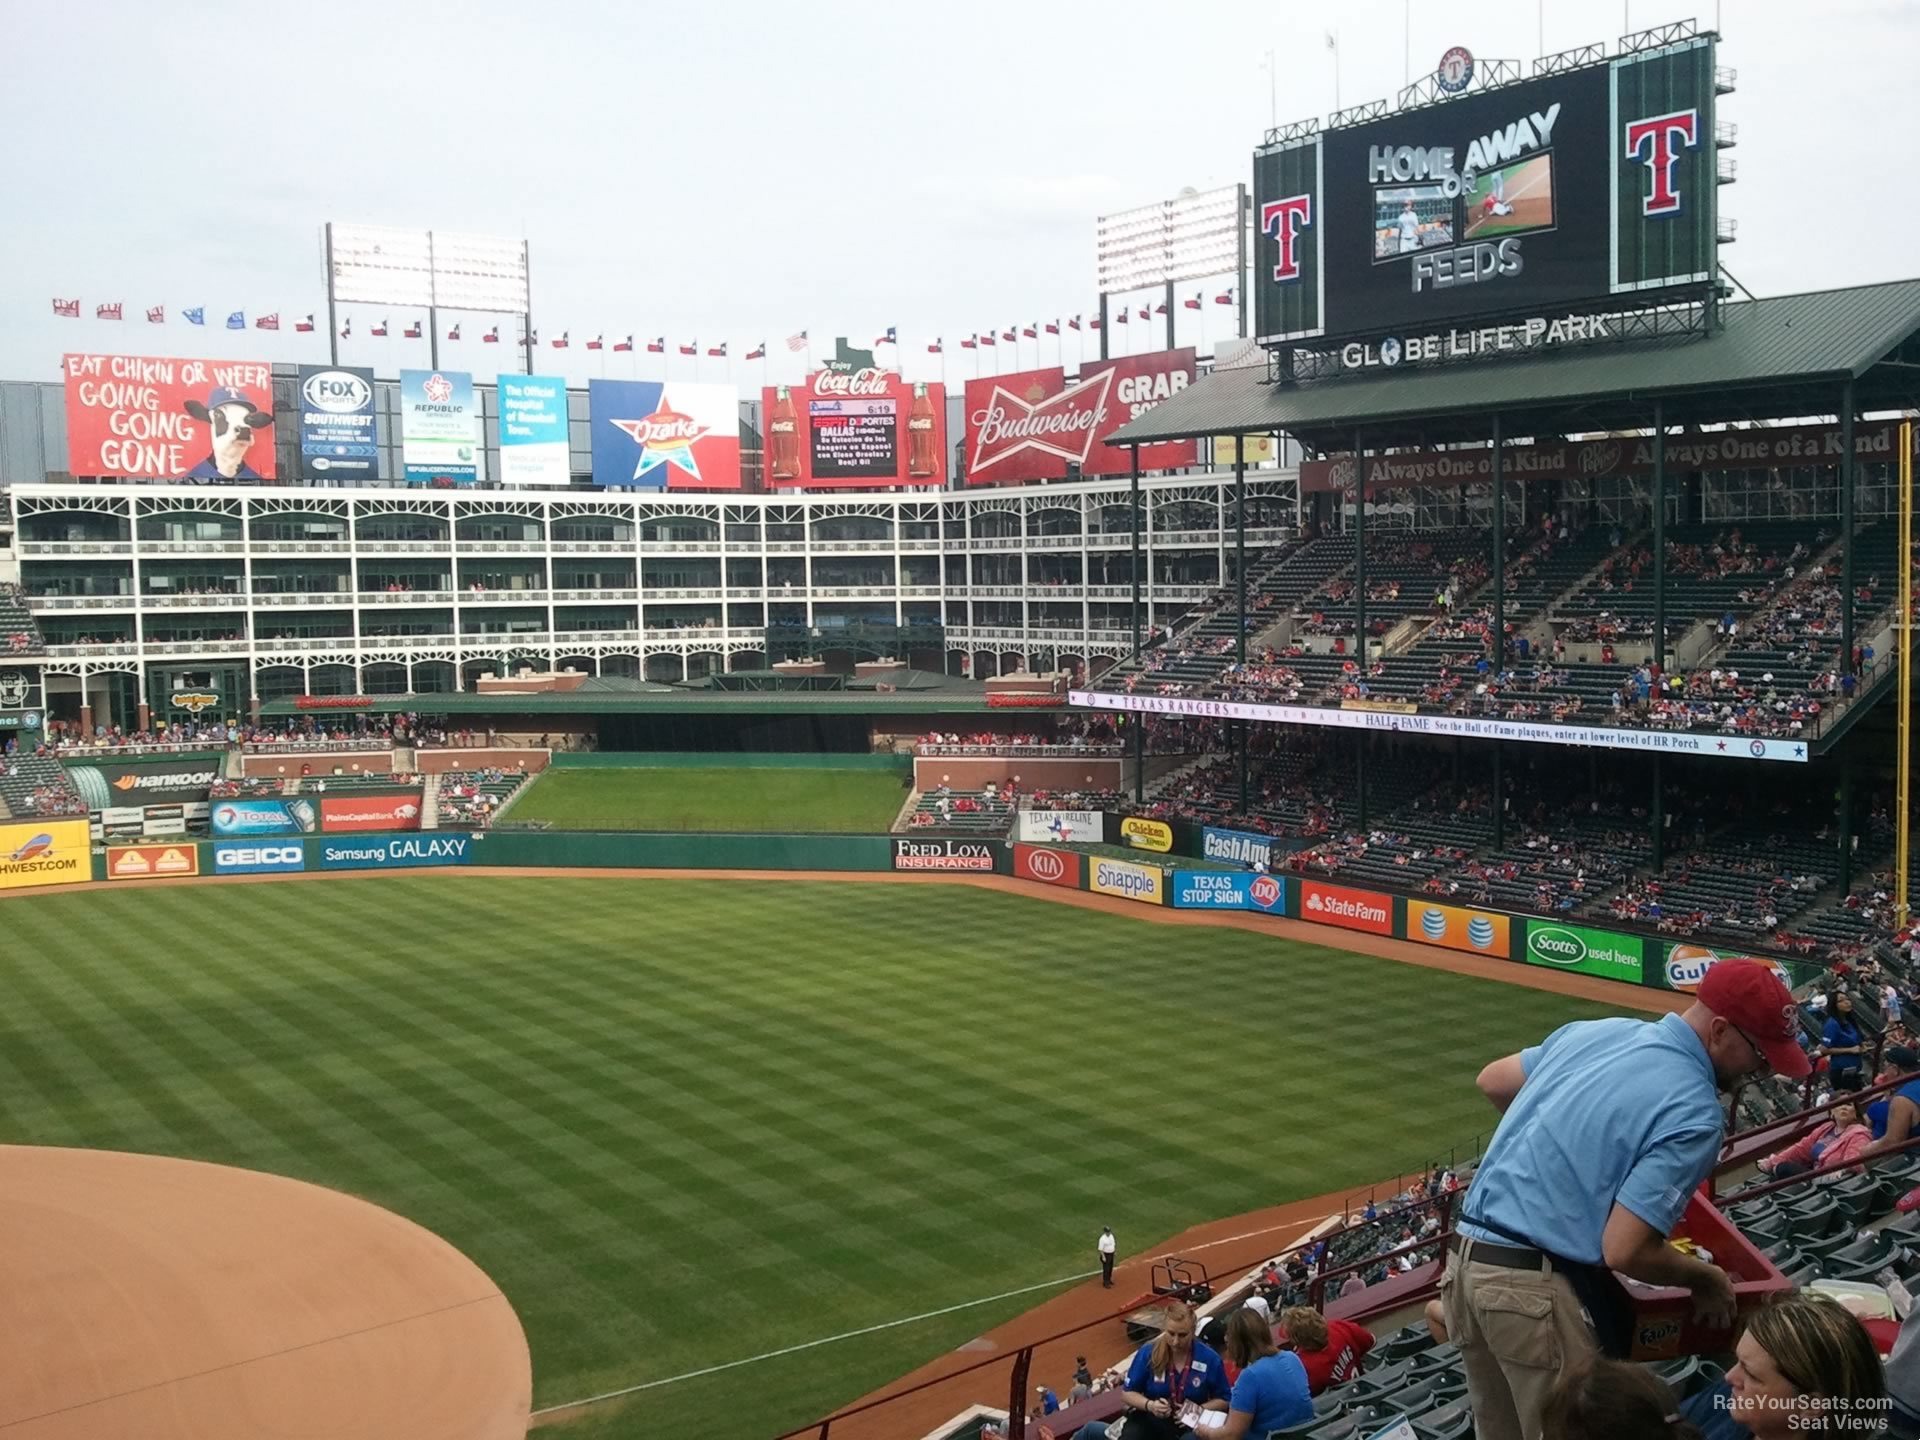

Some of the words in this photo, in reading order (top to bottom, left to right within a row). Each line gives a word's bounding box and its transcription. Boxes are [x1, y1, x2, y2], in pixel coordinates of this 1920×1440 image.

[1368, 145, 1455, 184] HOME
[1464, 102, 1560, 170] AWAY
[1625, 108, 1700, 217] T
[1442, 170, 1478, 199] OR
[1261, 193, 1310, 283] T
[1412, 238, 1523, 292] FEEDS
[1450, 324, 1514, 355] LIFE
[1524, 312, 1609, 347] PARK
[67, 357, 106, 377] EAT
[111, 357, 173, 384] CHIKIN
[182, 362, 208, 387] OR
[831, 361, 852, 371] Enjoy
[79, 381, 160, 411] GOING
[319, 380, 356, 396] FOX
[505, 385, 522, 396] The
[1118, 370, 1189, 403] GRAB
[319, 396, 358, 405] SPORTS
[414, 404, 462, 414] REPUBLIC
[868, 405, 890, 414] 6:19
[110, 410, 195, 441] GOING
[304, 413, 373, 427] SOUTHWEST
[506, 410, 516, 422] of
[849, 417, 895, 426] DEPORTES
[971, 402, 1107, 446] Budweiser
[633, 415, 699, 442] Ozarka
[820, 427, 855, 437] DALLAS
[1720, 437, 1770, 459] One
[1823, 428, 1890, 454] Knd
[100, 439, 187, 475] GONE
[1369, 459, 1437, 481] Always
[1440, 458, 1474, 476] One
[1515, 450, 1565, 472] Kind
[1123, 696, 1164, 712] TEXAS
[1168, 699, 1229, 716] RANGERS
[1366, 714, 1391, 728] HALL
[1401, 717, 1430, 730] FAME
[1435, 720, 1447, 730] See
[1450, 721, 1461, 731] the
[1465, 722, 1481, 733] Hall
[1484, 723, 1492, 733] of
[1494, 725, 1515, 735] Fame
[1517, 726, 1552, 739] plaques,
[1555, 729, 1576, 740] enter
[1580, 731, 1588, 740] at
[1591, 731, 1615, 742] lower
[1618, 733, 1638, 744] level
[1642, 735, 1651, 745] of
[1654, 736, 1668, 747] HR
[1672, 737, 1698, 749] Porch
[149, 784, 179, 793] driving
[240, 811, 287, 821] TOTAL
[1029, 812, 1053, 824] TEXAS
[1055, 812, 1092, 825] WIRELINE
[1128, 822, 1164, 838] Chicken
[216, 847, 302, 866] GEICO
[325, 848, 385, 862] Samsung
[389, 839, 466, 857] GALAXY
[896, 840, 941, 857] FRED
[945, 840, 991, 857] LOYA
[898, 858, 990, 868] INSURANCE
[1033, 855, 1058, 875] KIA
[1097, 863, 1154, 896] Snapple
[1193, 875, 1231, 890] TEXAS
[1183, 890, 1212, 903] STOP
[1215, 891, 1243, 904] SIGN
[1255, 883, 1276, 898] DQ
[1537, 935, 1578, 956] Scotts
[1588, 946, 1612, 962] used
[1614, 950, 1640, 968] here.
[1330, 1344, 1354, 1382] YOUNG
